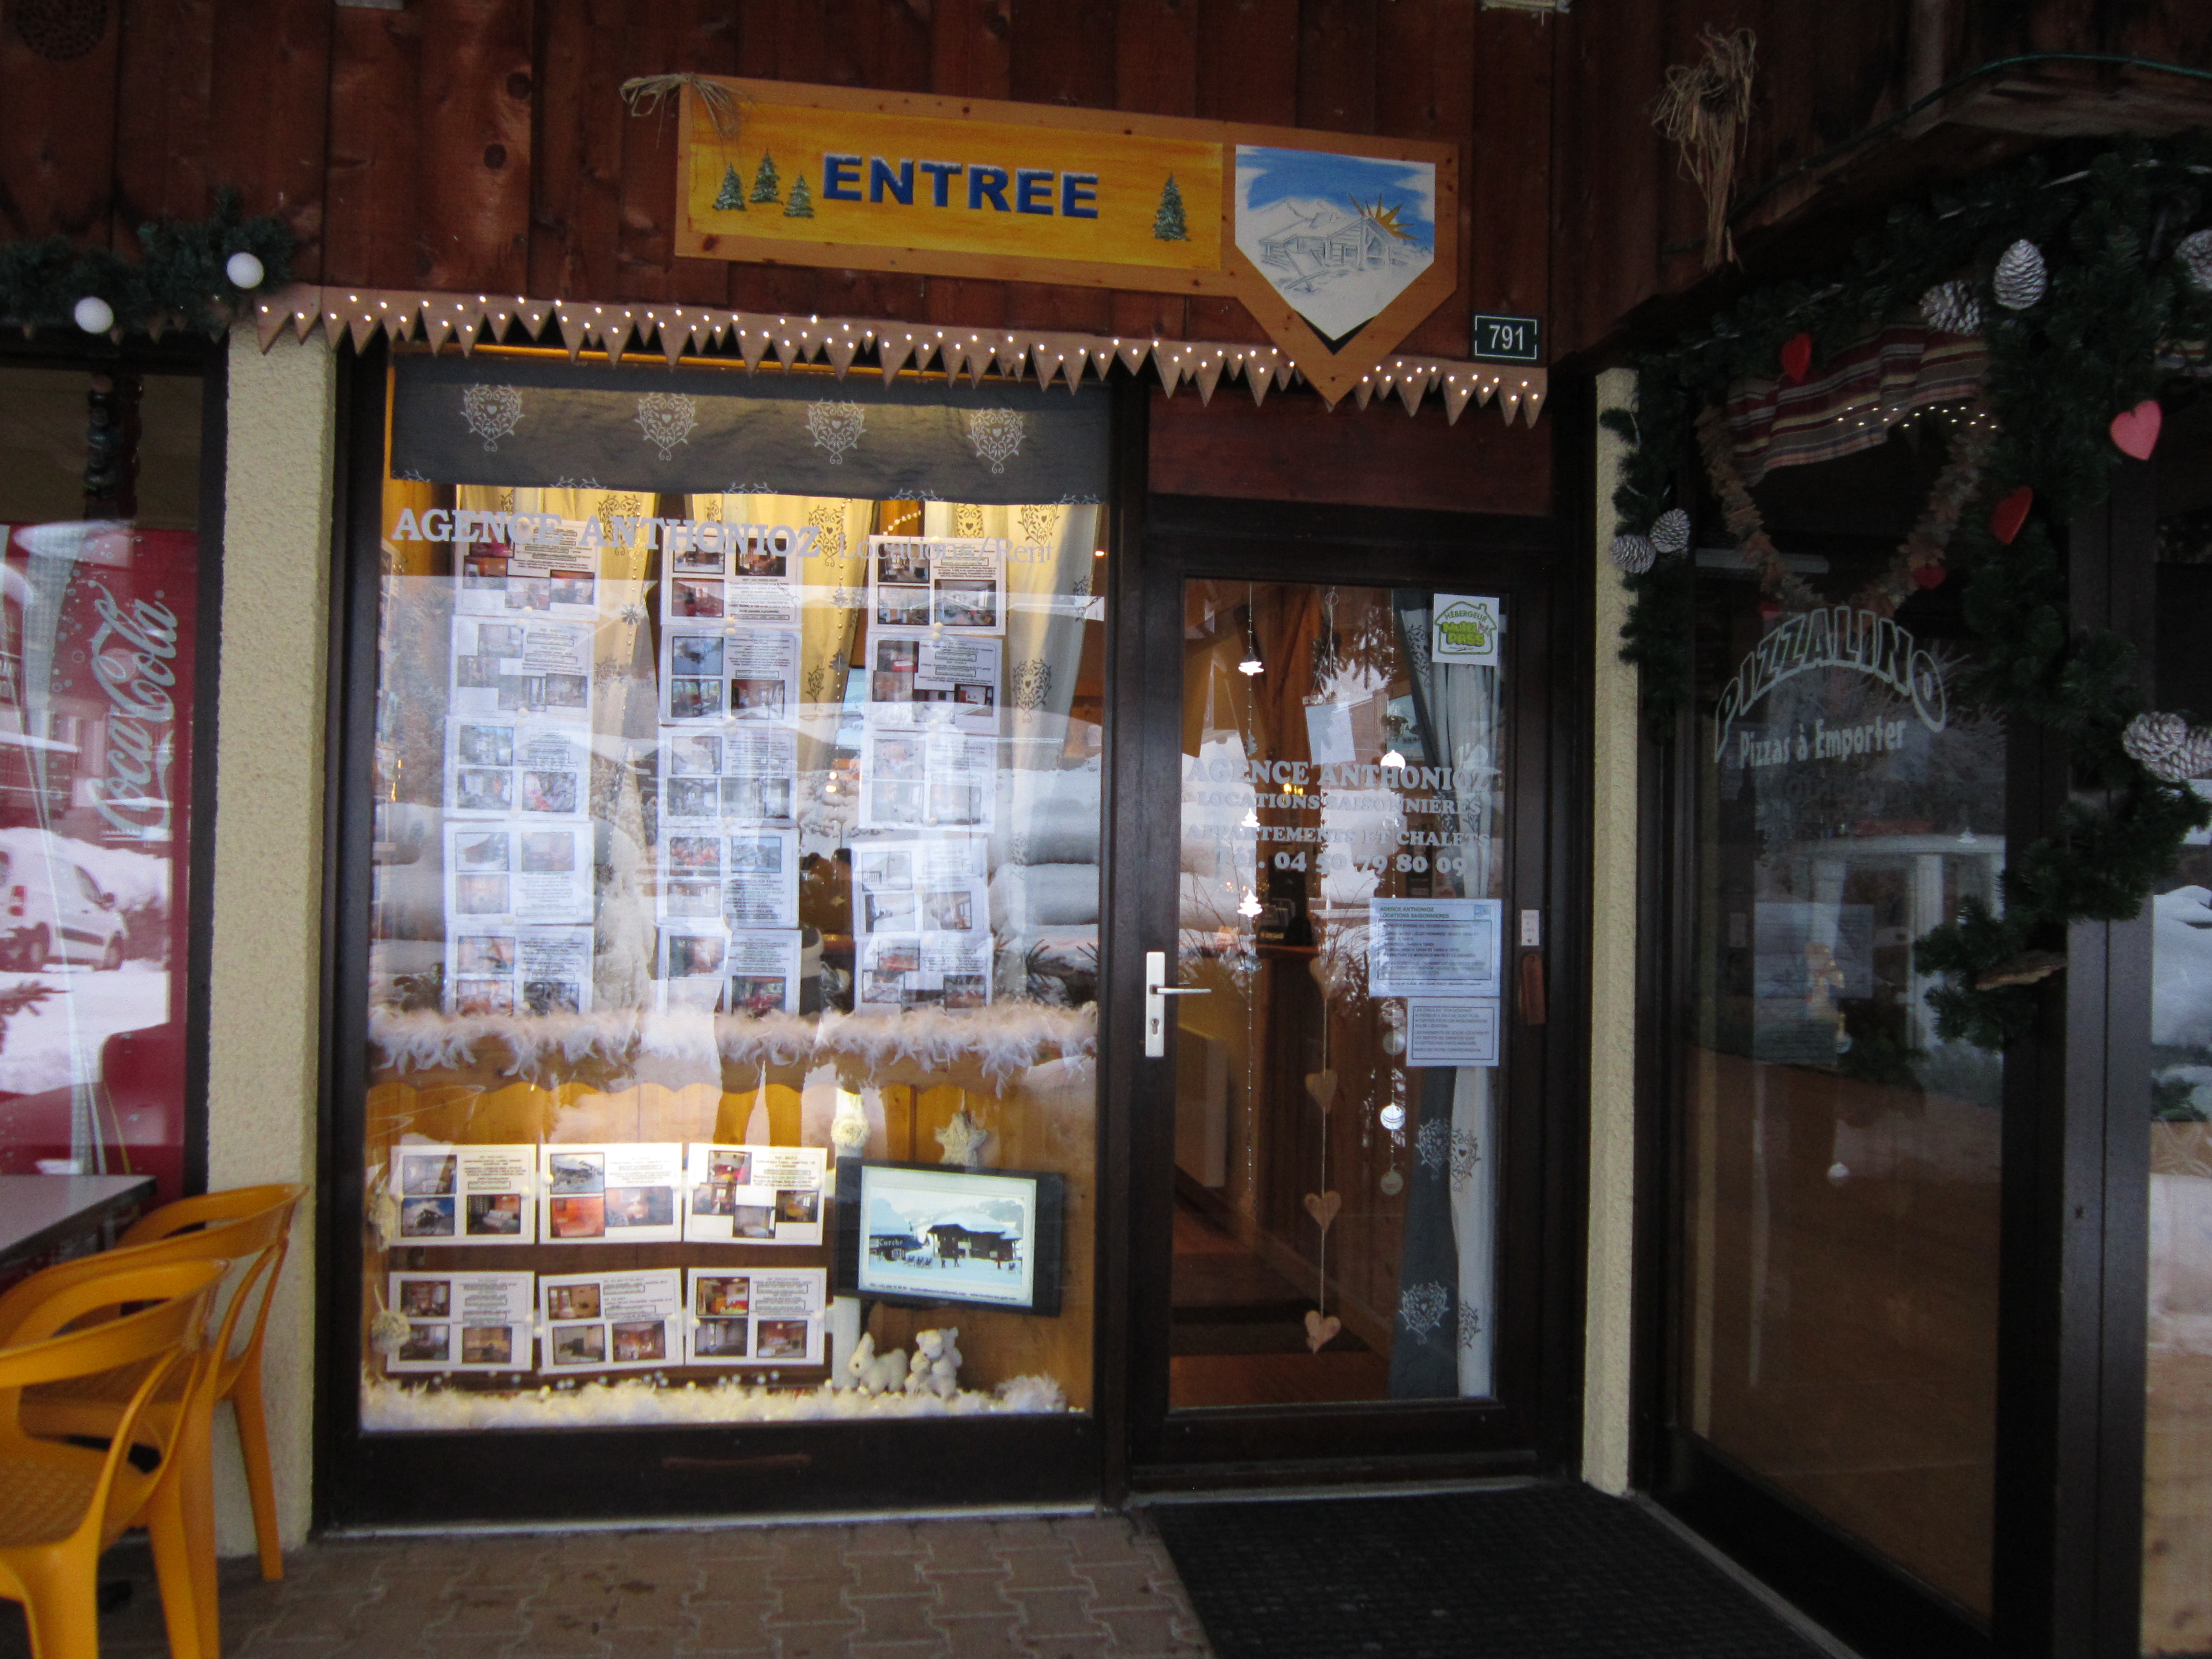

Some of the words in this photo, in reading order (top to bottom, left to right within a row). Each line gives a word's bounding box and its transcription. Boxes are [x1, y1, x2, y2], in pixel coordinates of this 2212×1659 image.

[823, 153, 1098, 219] ENTREE
[1489, 325, 1523, 351] 791
[392, 508, 562, 544] AGENCE
[579, 515, 819, 557] ANTHONIOZ
[1715, 606, 1945, 763] PIZZALINO
[1740, 731, 1790, 768] Pizzas
[1797, 723, 1809, 761] à
[1815, 715, 1906, 761] Emporter
[1187, 758, 1310, 785] AGENCE
[1317, 762, 1492, 791] ANTHONIOZ
[1198, 791, 1320, 809] LOCATIONS
[1187, 824, 1356, 843] APPARTEMENTS
[1364, 830, 1391, 844] ET
[1396, 831, 1491, 845] CHALETS
[1274, 851, 1306, 871] 04
[1356, 854, 1388, 875] 79
[1396, 854, 1428, 873] 80
[1436, 857, 1467, 876] 09
